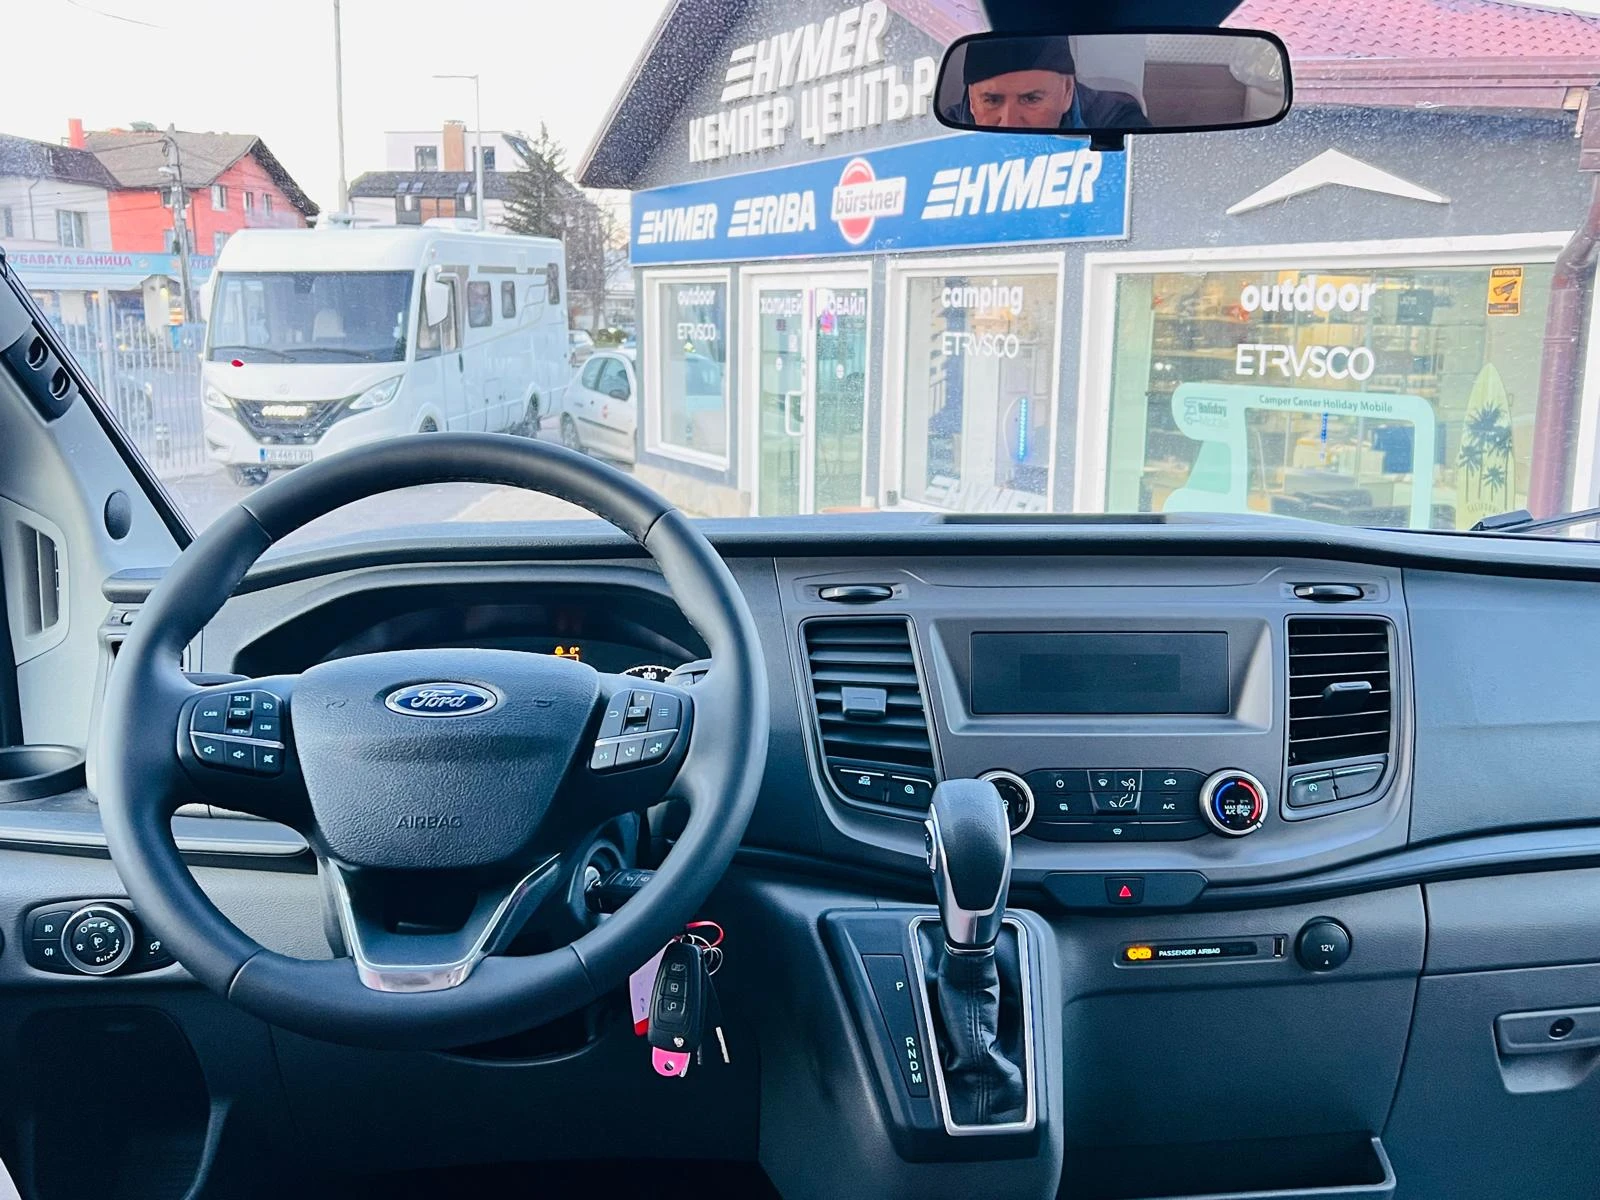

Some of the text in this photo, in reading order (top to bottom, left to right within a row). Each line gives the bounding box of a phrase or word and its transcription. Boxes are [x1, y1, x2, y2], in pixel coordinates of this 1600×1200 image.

[721, 0, 888, 101] HYMER
[689, 56, 936, 163] КЕМПЕР ЦЕНТЪР
[921, 148, 1102, 219] HYMER
[835, 187, 902, 215] bürstner
[727, 190, 817, 238] ERIBA
[637, 203, 719, 244] HYMER
[941, 278, 1023, 315] camping
[1240, 274, 1377, 312] outdoor
[1259, 395, 1393, 413] Camper Center Holiday Mobile
[642, 671, 657, 680] 100
[410, 689, 468, 708] Ford
[396, 815, 462, 829] AIRBAG
[1158, 947, 1221, 957] PASSENGER AIRBAG
[1320, 944, 1335, 952] 12V
[895, 981, 904, 991] P
[905, 1036, 915, 1047] R
[907, 1049, 917, 1059] N
[909, 1061, 919, 1071] D
[911, 1073, 922, 1084] M
